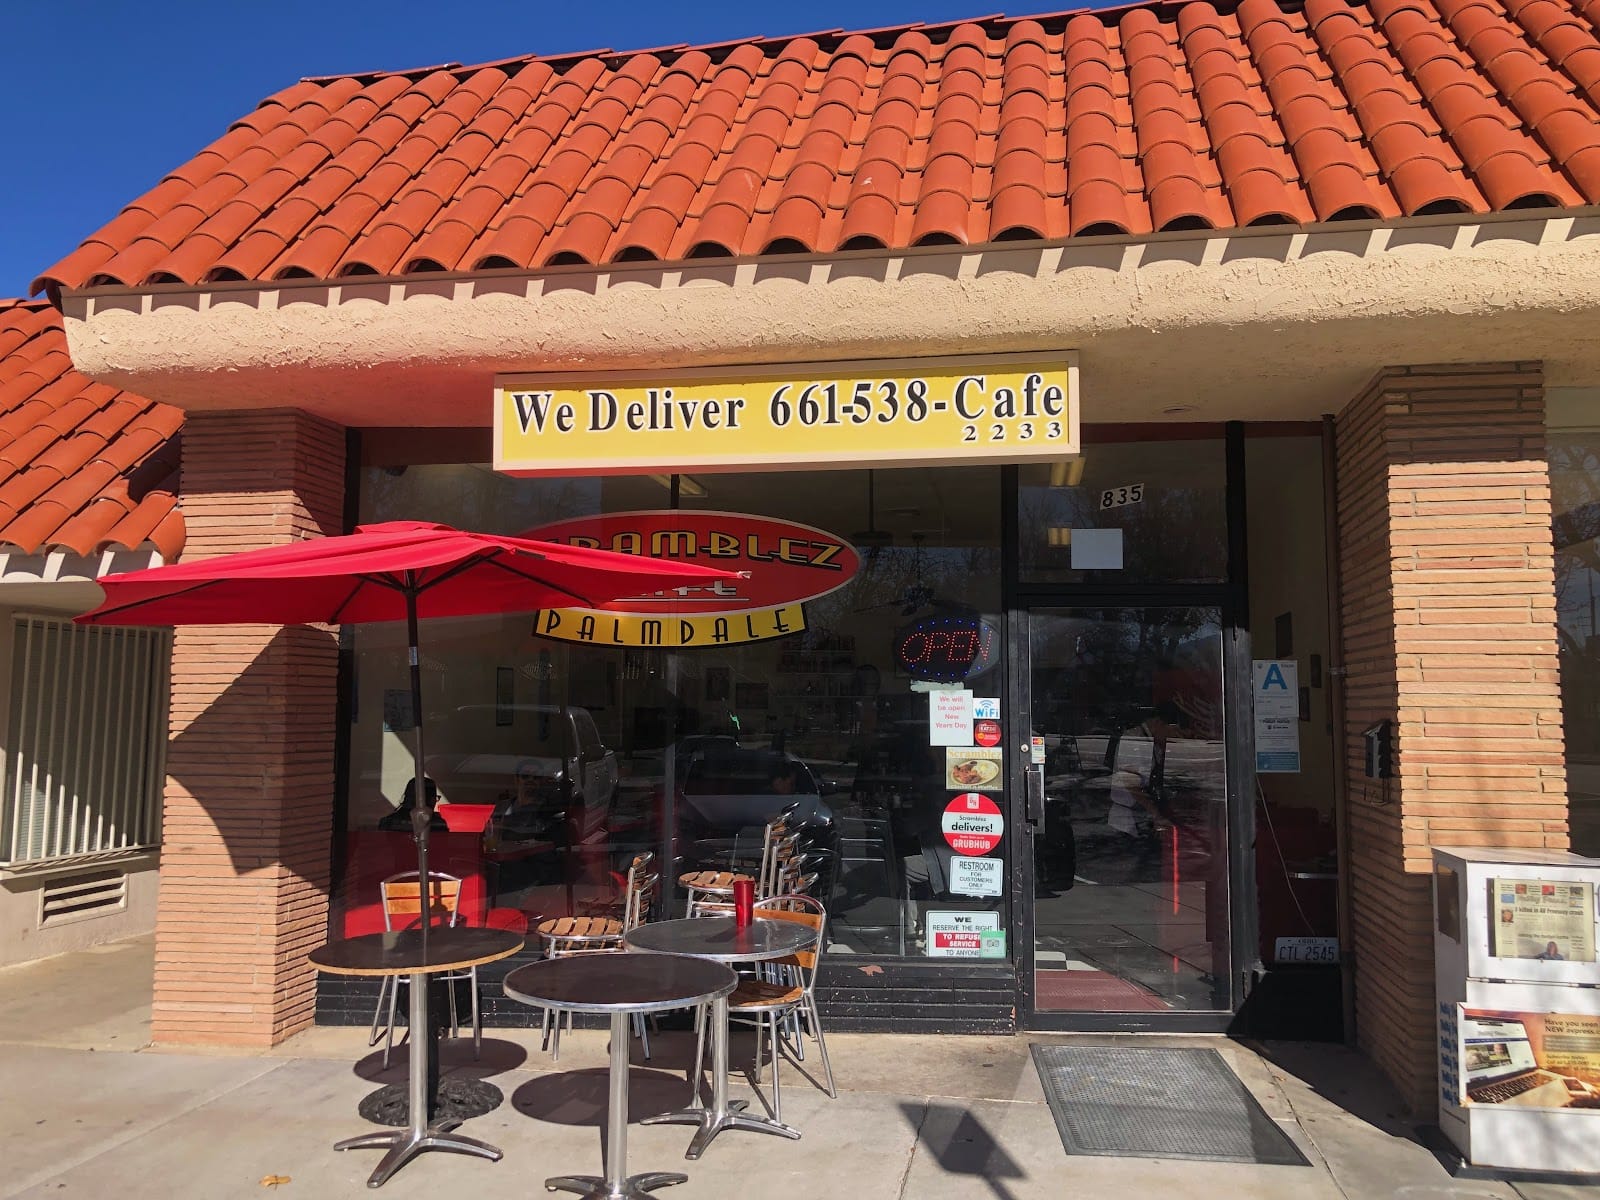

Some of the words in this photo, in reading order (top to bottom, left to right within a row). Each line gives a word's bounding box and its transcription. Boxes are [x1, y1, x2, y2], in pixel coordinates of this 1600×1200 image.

[512, 393, 575, 433] We
[588, 390, 745, 431] Deliver
[1102, 485, 1142, 508] 835
[547, 530, 843, 570] AMBLEZ
[545, 608, 791, 645] PALMDALE
[902, 630, 993, 663] OPEN
[1262, 663, 1288, 690] A
[952, 695, 964, 703] will
[954, 722, 968, 730] Day
[951, 822, 993, 833] delivers!
[952, 838, 991, 850] GRUBHUB
[959, 860, 994, 871] RESTROOM
[1279, 945, 1301, 961] CTL
[1305, 945, 1336, 961] 2545
